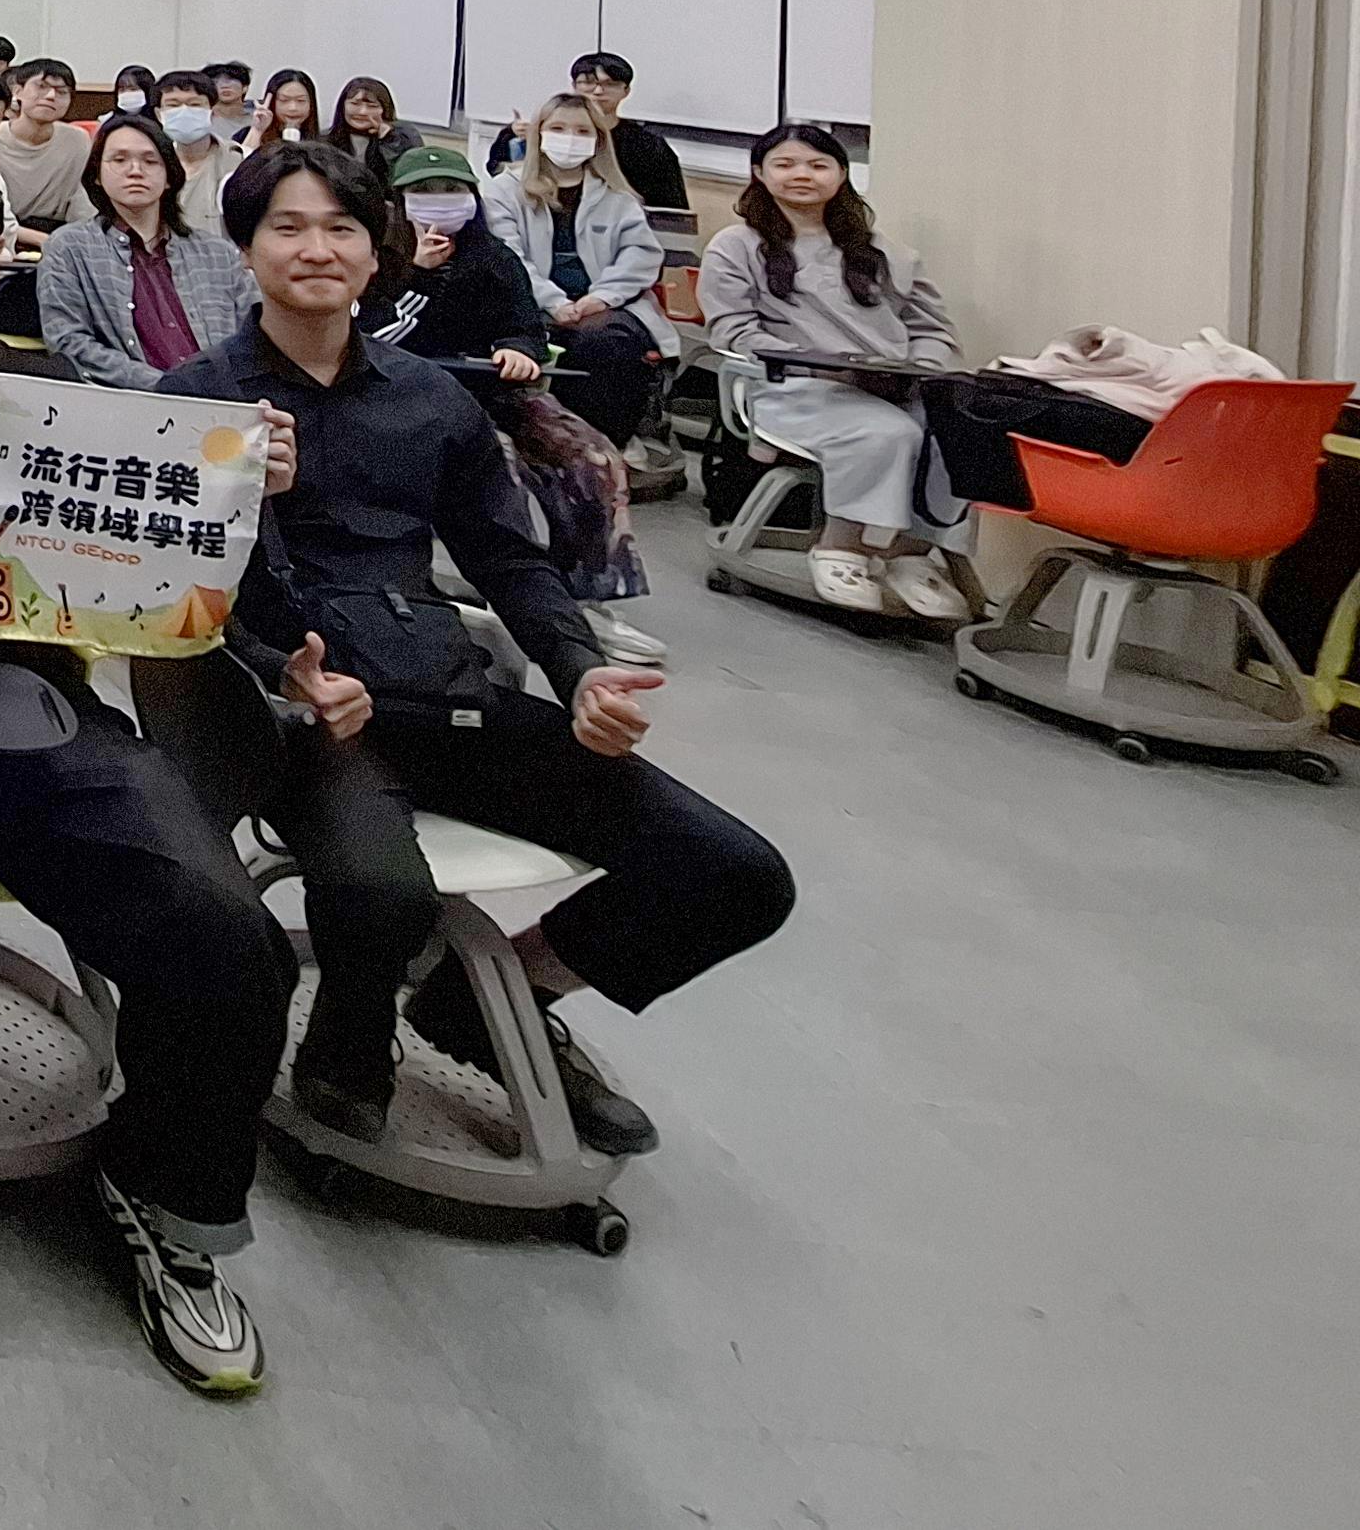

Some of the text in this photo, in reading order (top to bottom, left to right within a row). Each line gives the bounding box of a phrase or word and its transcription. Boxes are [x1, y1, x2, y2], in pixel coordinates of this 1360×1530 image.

[20, 443, 200, 507] 流行音樂
[15, 534, 66, 551] NTCU
[19, 489, 226, 559] 跨領域學程
